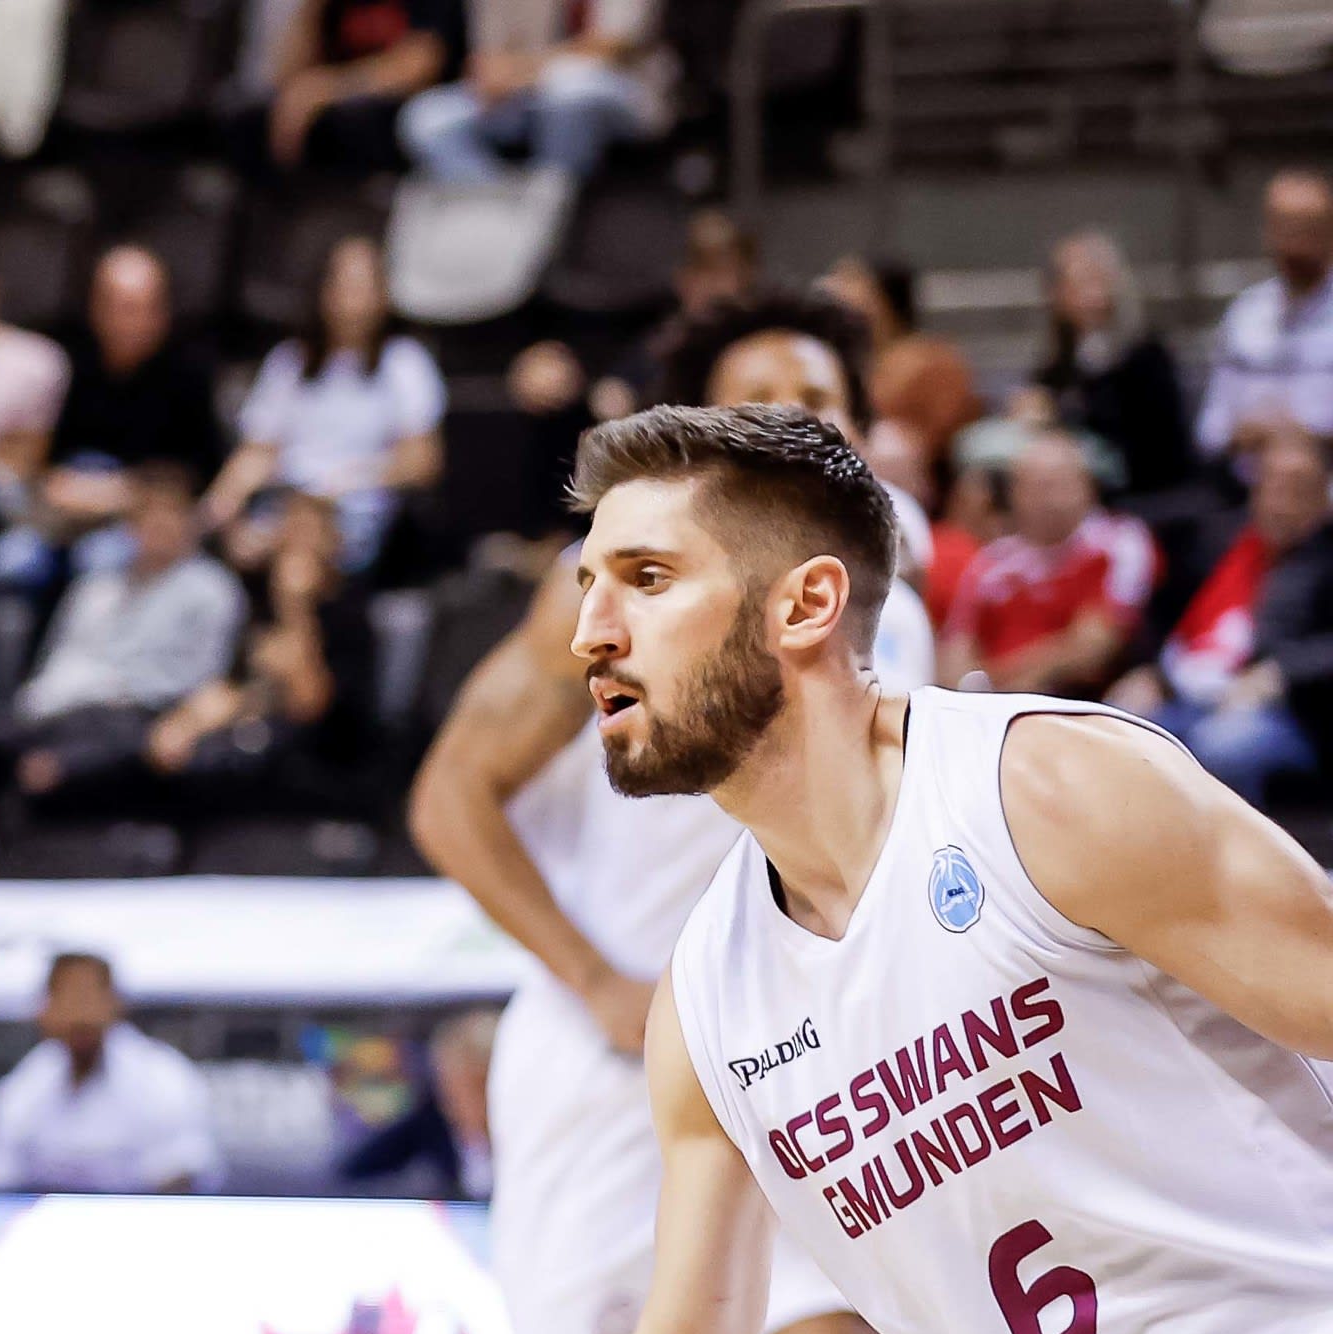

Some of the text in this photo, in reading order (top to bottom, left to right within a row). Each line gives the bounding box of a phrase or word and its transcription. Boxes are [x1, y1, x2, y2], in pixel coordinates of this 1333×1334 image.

[768, 976, 1065, 1180] OCS SWANS
[822, 1051, 1083, 1240] GMUNDEN
